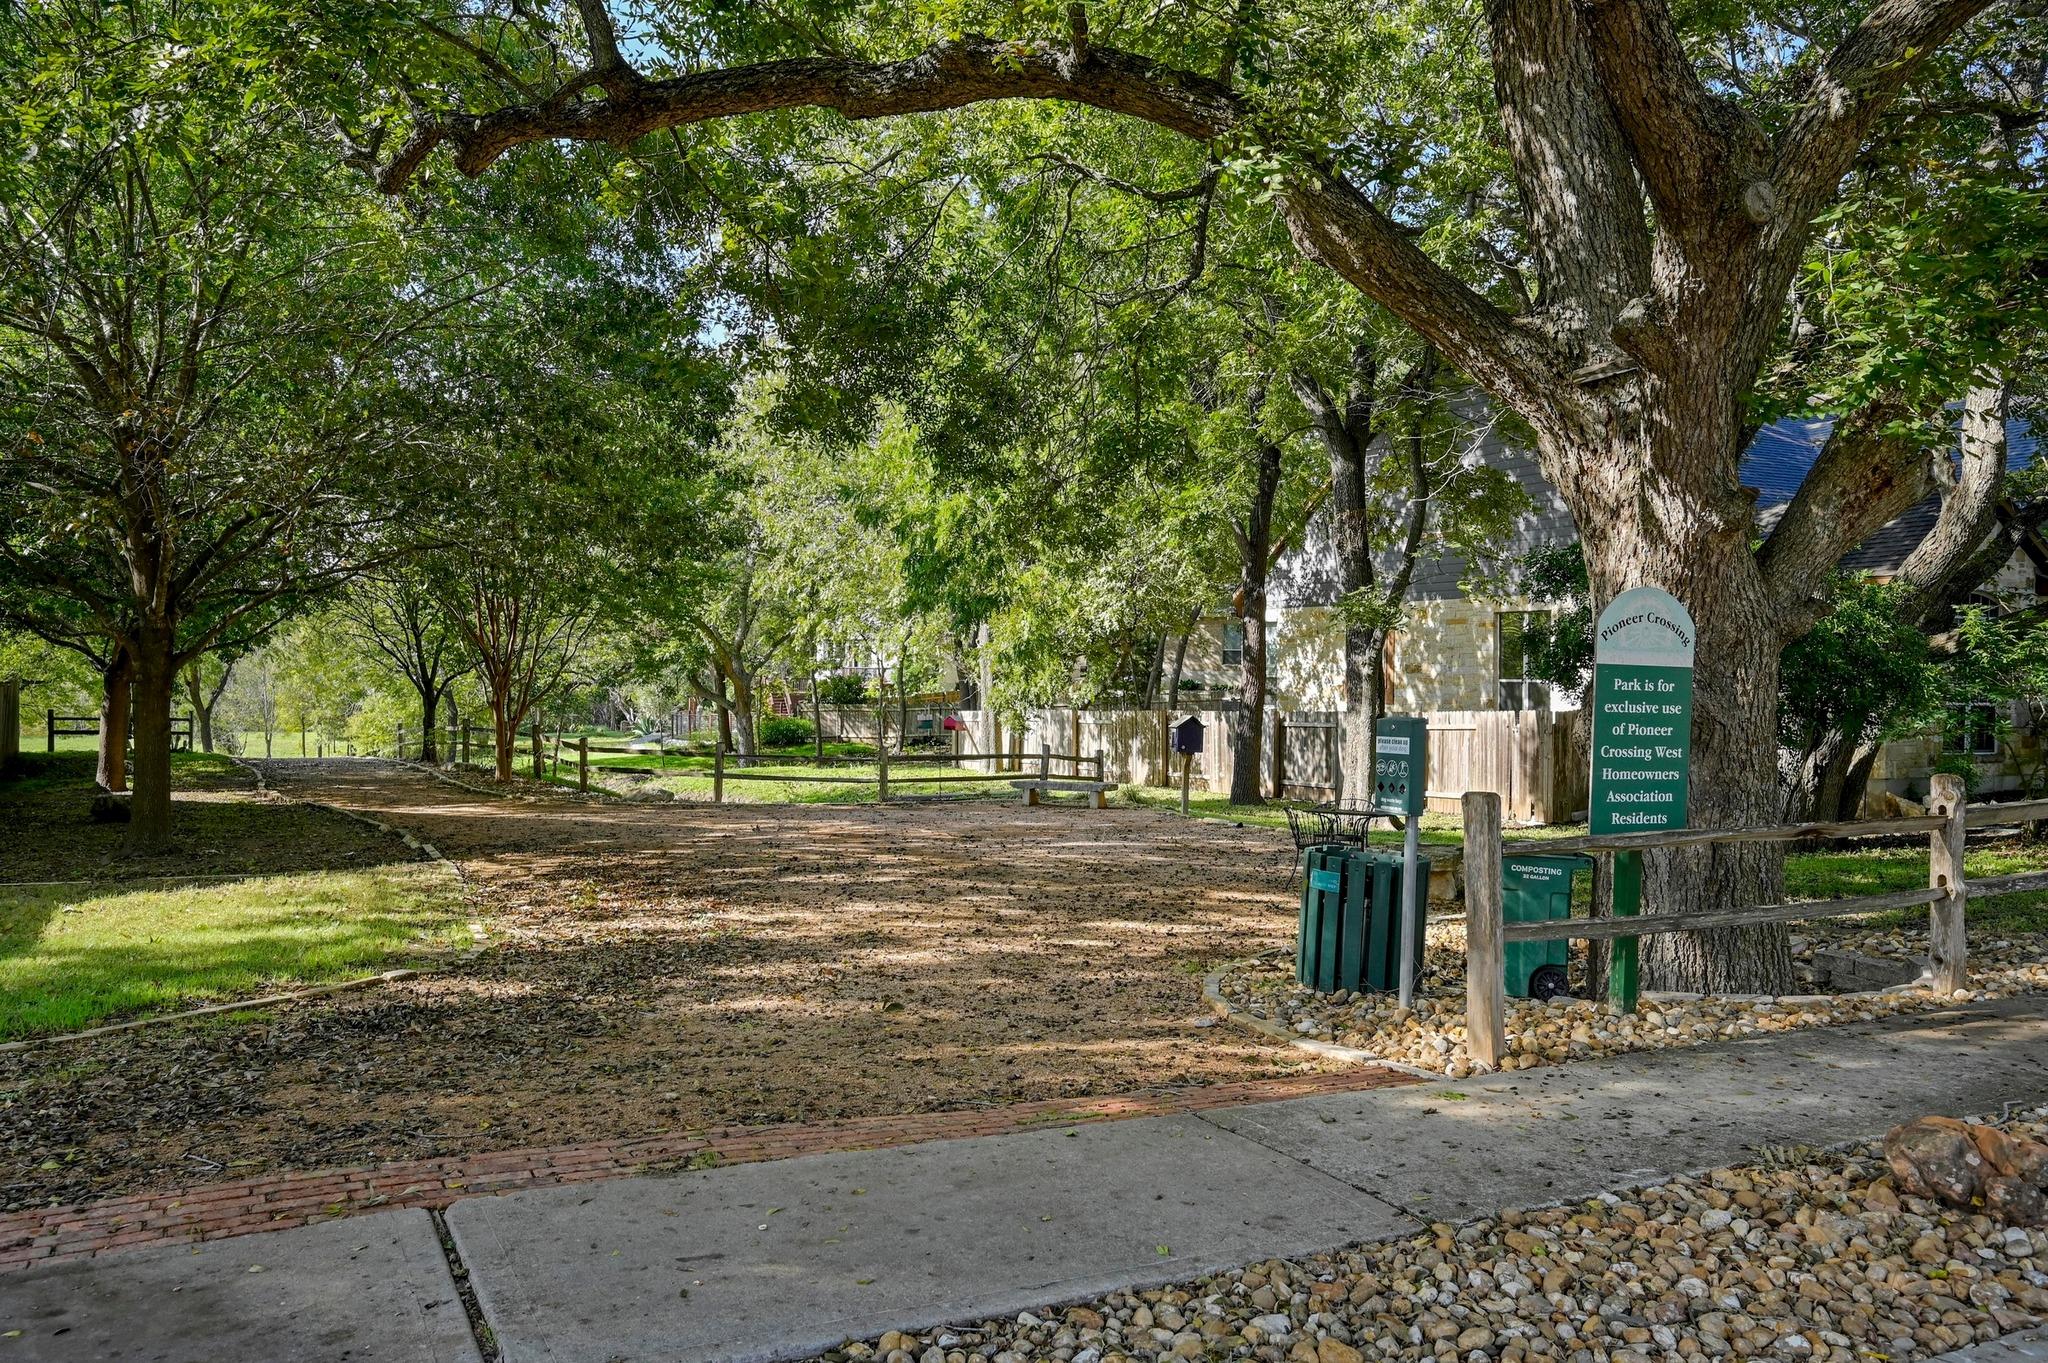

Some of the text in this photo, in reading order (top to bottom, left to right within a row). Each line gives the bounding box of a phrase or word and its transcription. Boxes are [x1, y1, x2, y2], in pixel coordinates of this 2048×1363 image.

[1601, 612, 1691, 648] Pioneer Crossing
[1614, 678, 1675, 692] Park is for
[1604, 700, 1682, 715] exclusive use
[1612, 723, 1673, 736] of Pioneer
[1601, 745, 1683, 761] Crossing West
[1602, 767, 1680, 780] Homeowners
[1606, 790, 1673, 802] Association
[1611, 812, 1668, 825] Residents
[1511, 864, 1562, 876] COMPOSTING
